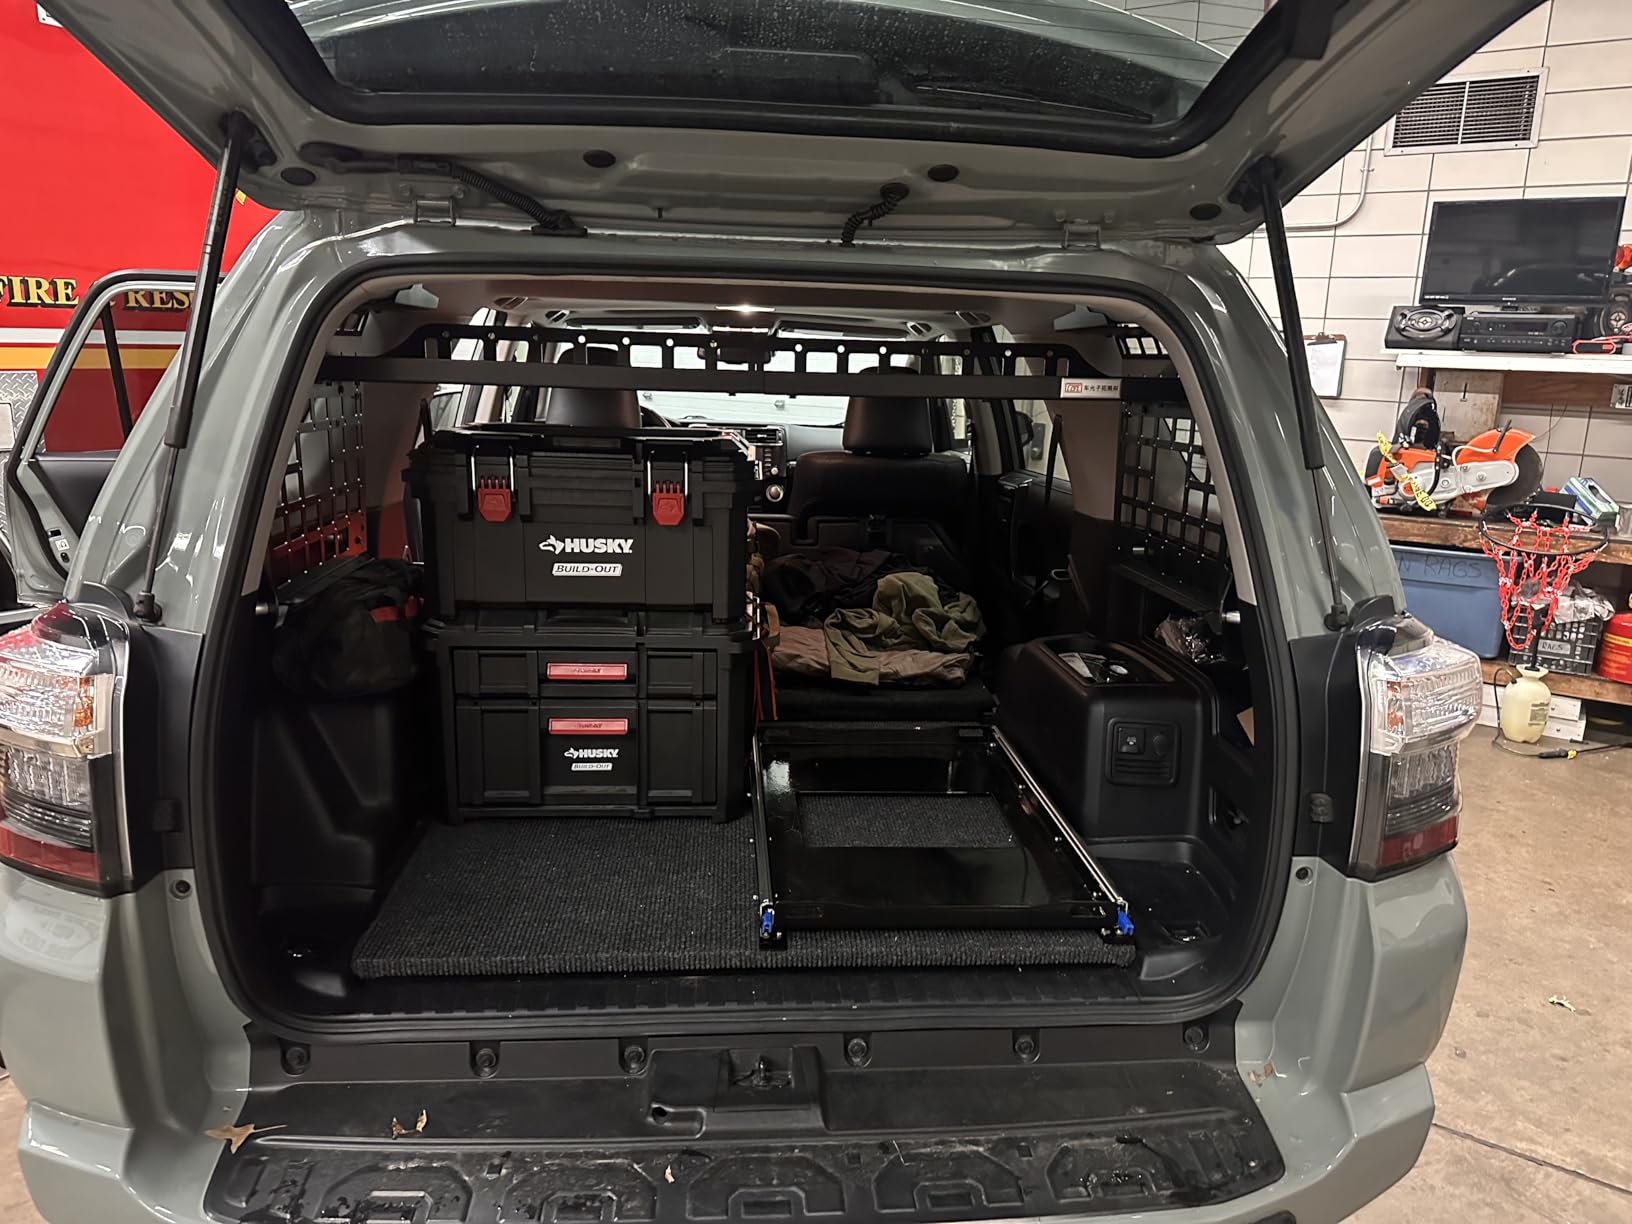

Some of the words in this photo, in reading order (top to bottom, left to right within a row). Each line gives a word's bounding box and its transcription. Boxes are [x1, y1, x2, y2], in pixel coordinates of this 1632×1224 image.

[126, 290, 195, 309] RES
[564, 538, 634, 553] HUSKY
[554, 564, 620, 574] BUILD-OUT
[1423, 555, 1482, 578] RAGS
[578, 748, 619, 758] HUSKY
